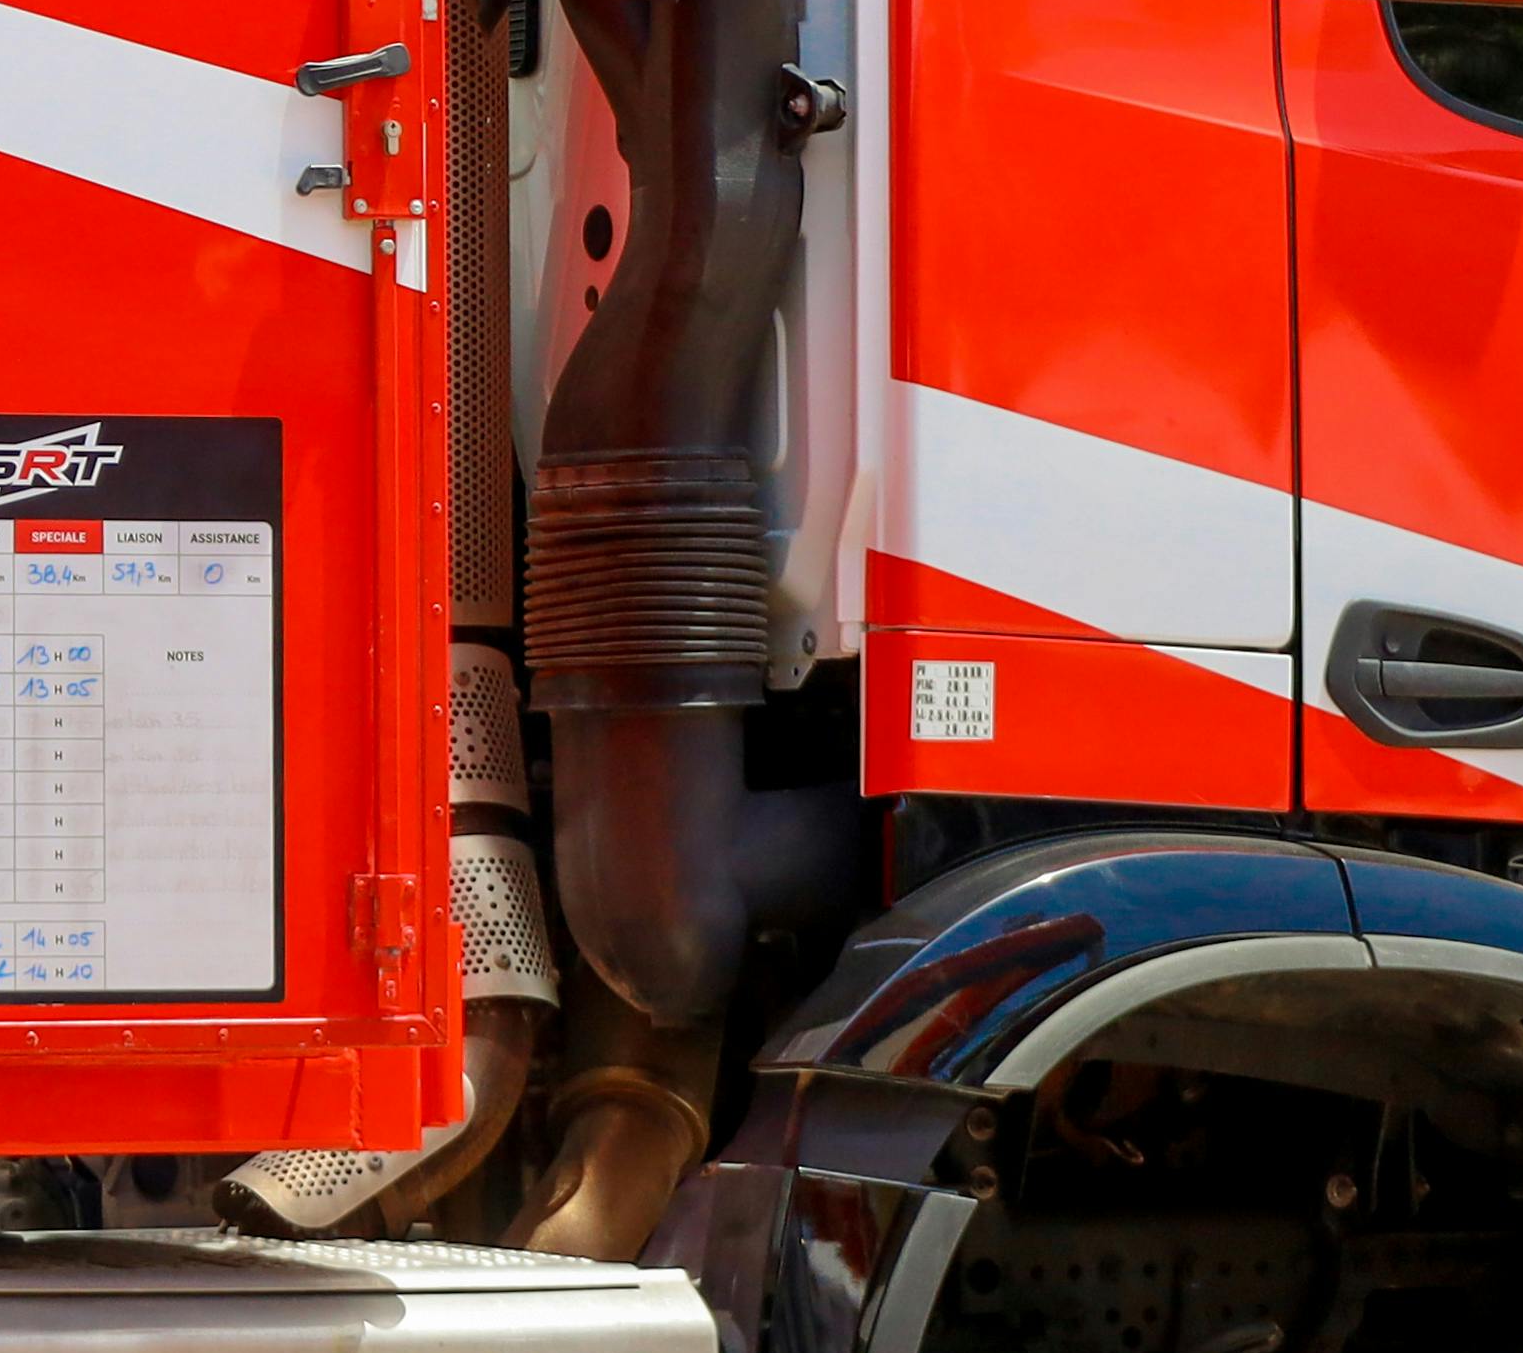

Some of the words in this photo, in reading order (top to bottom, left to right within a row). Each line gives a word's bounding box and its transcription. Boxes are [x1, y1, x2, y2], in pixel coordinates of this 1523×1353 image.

[31, 531, 86, 543] SPECIALE
[117, 532, 163, 544] LIAISON
[190, 533, 260, 544] ASSISTANCE
[72, 574, 86, 582] Km
[158, 575, 171, 583] Km
[247, 575, 260, 584] Km
[54, 653, 62, 661] H
[167, 651, 204, 662] NOTES
[54, 685, 62, 694] H
[55, 718, 63, 727] H
[55, 751, 63, 760] H
[55, 784, 63, 793] H
[55, 818, 63, 827] H
[55, 851, 63, 860] H
[55, 884, 63, 893] H
[55, 936, 63, 944] H
[55, 970, 63, 978] H
